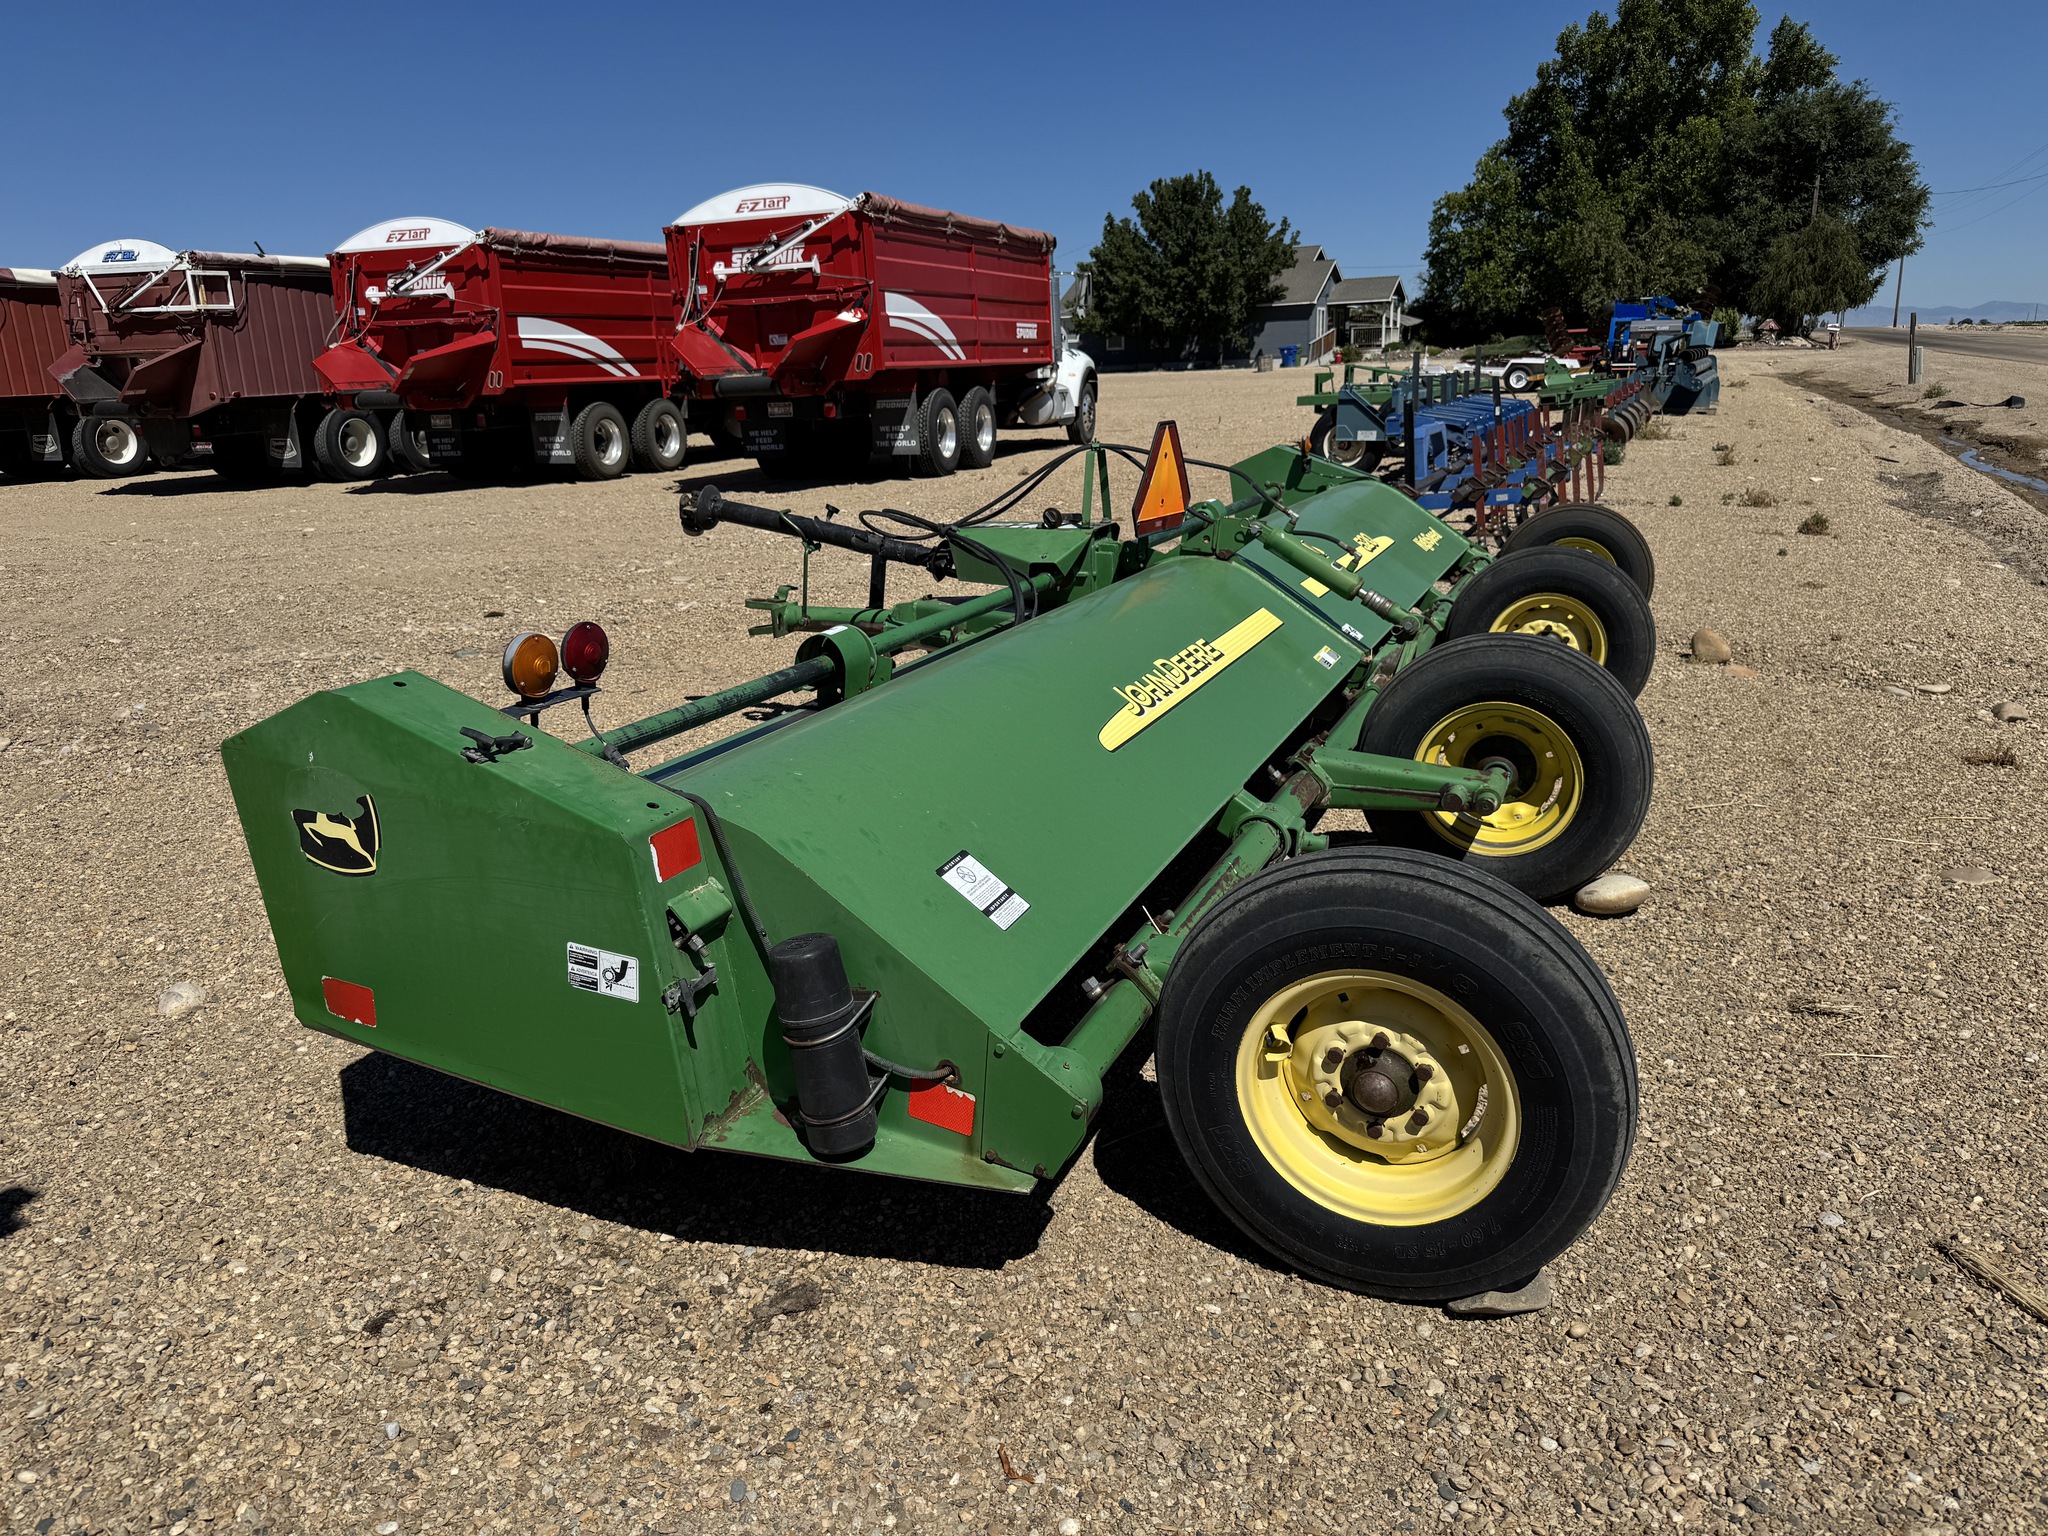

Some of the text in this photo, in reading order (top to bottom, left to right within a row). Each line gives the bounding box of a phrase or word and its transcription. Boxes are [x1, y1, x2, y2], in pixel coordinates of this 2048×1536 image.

[1112, 638, 1225, 716] JOHN DEERE
[575, 945, 598, 955] WARNING
[1212, 988, 1248, 1040] FARM
[1244, 942, 1377, 988] IMPLEMENT
